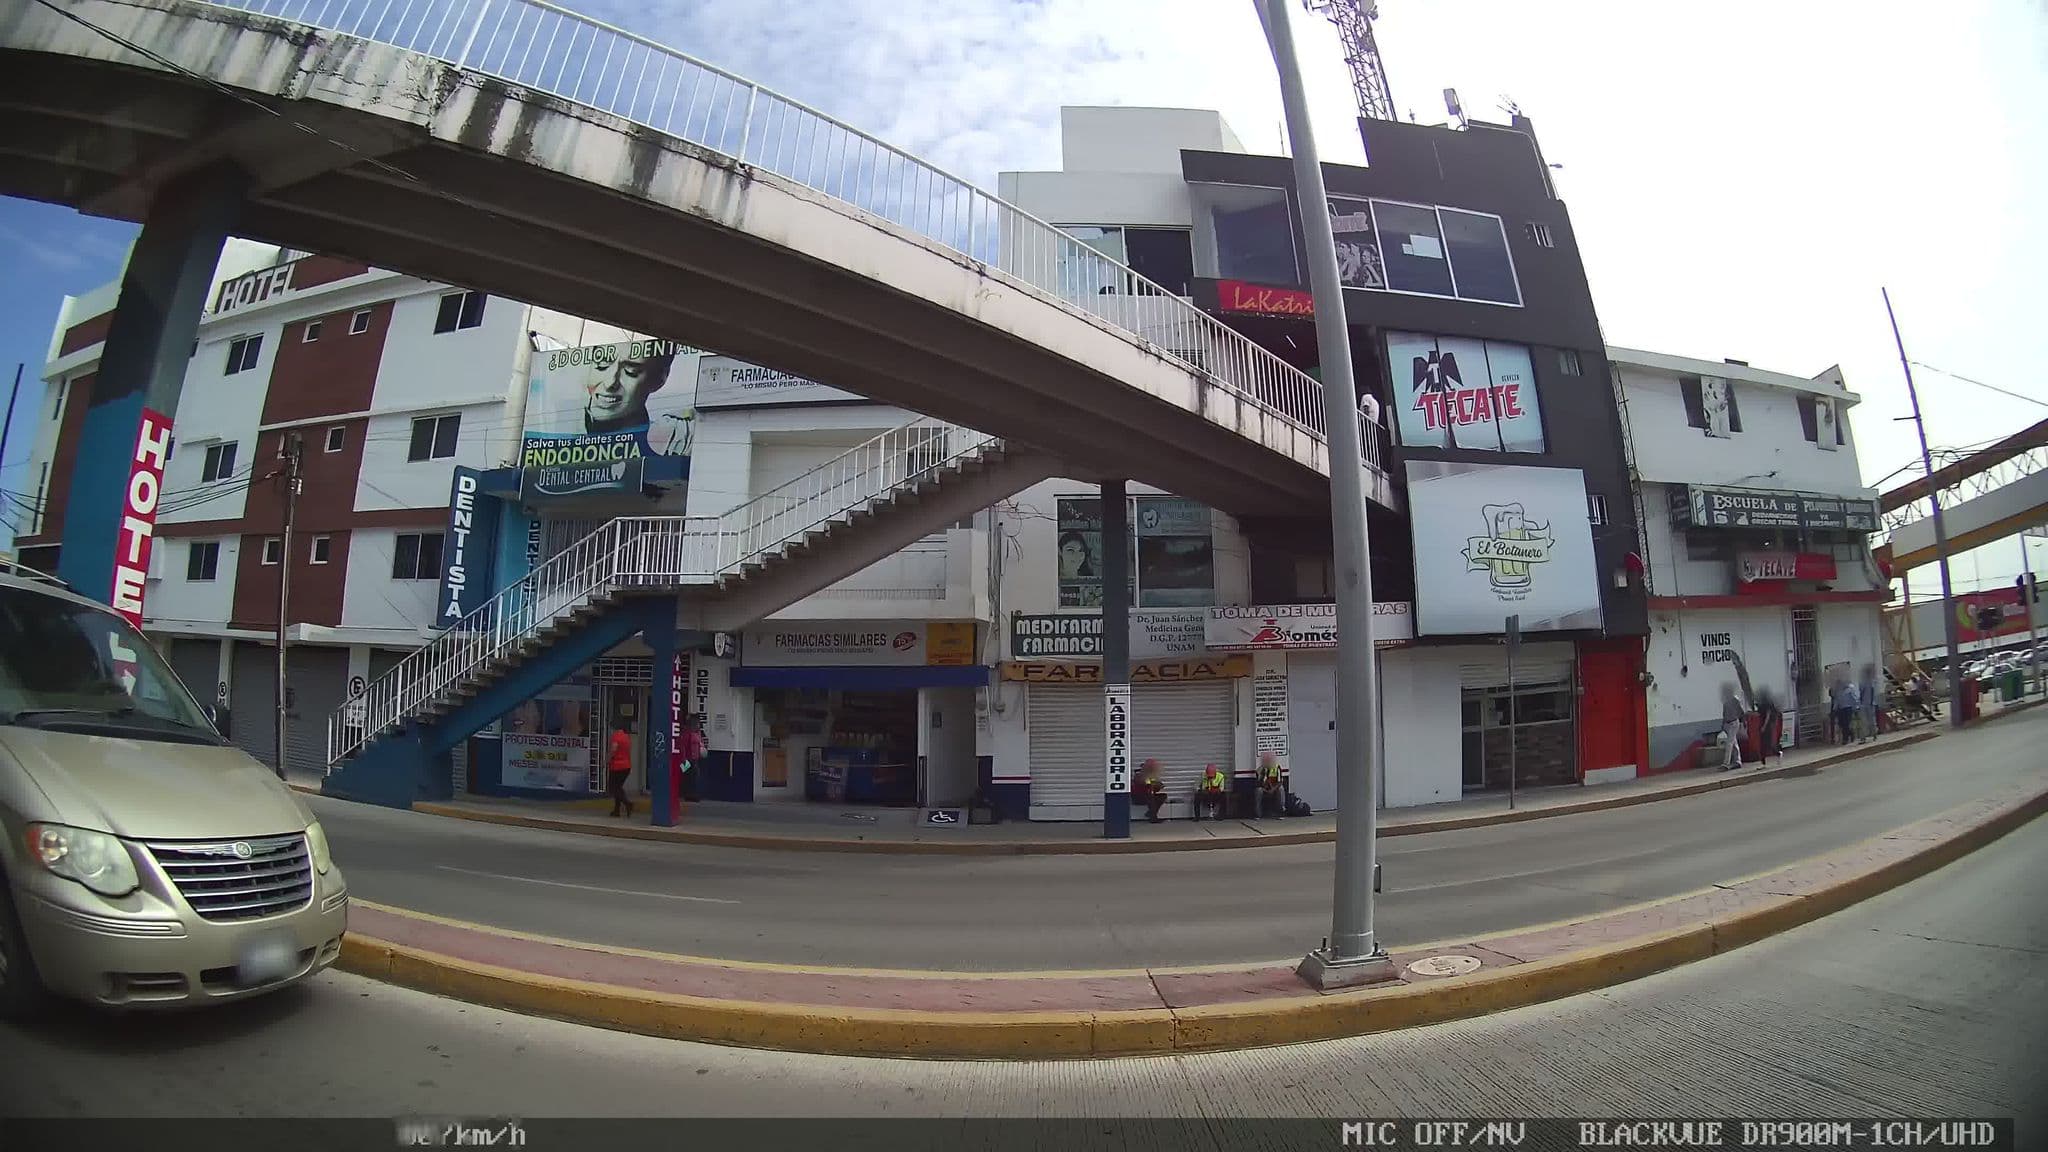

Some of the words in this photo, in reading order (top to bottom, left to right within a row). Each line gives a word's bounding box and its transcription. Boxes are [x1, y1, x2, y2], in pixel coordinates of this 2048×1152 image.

[217, 262, 297, 314] HOTEL
[548, 345, 618, 371] ¿DOLOR
[731, 367, 794, 383] FARMACIA
[1413, 385, 1522, 430] TECATE
[527, 438, 554, 449] Salva
[558, 437, 571, 447] tus
[575, 434, 612, 446] dientes
[615, 433, 634, 442] con
[524, 442, 641, 467] ENDODONCIA
[539, 469, 570, 486] DENTAL
[574, 467, 611, 484] CENTRAL
[1712, 494, 1778, 510] ESCUELA
[1784, 503, 1797, 511] DE
[445, 476, 477, 618] DENTISTA
[1477, 541, 1490, 554] El
[1493, 542, 1543, 558] Botanero
[1152, 616, 1170, 624] Juan
[1211, 606, 1272, 619] TOMA
[1277, 606, 1302, 618] DE
[1145, 625, 1182, 633] Medicina
[775, 633, 831, 647] FARMACIAS
[833, 632, 887, 647] SIMILARES
[1022, 637, 1104, 652] FARMACI
[1167, 643, 1195, 651] UNAM
[1700, 632, 1731, 647] VINOS
[1012, 662, 1225, 677] "FARACIA"
[671, 675, 681, 754] HOTEL
[1110, 697, 1126, 791] LABORATORIO
